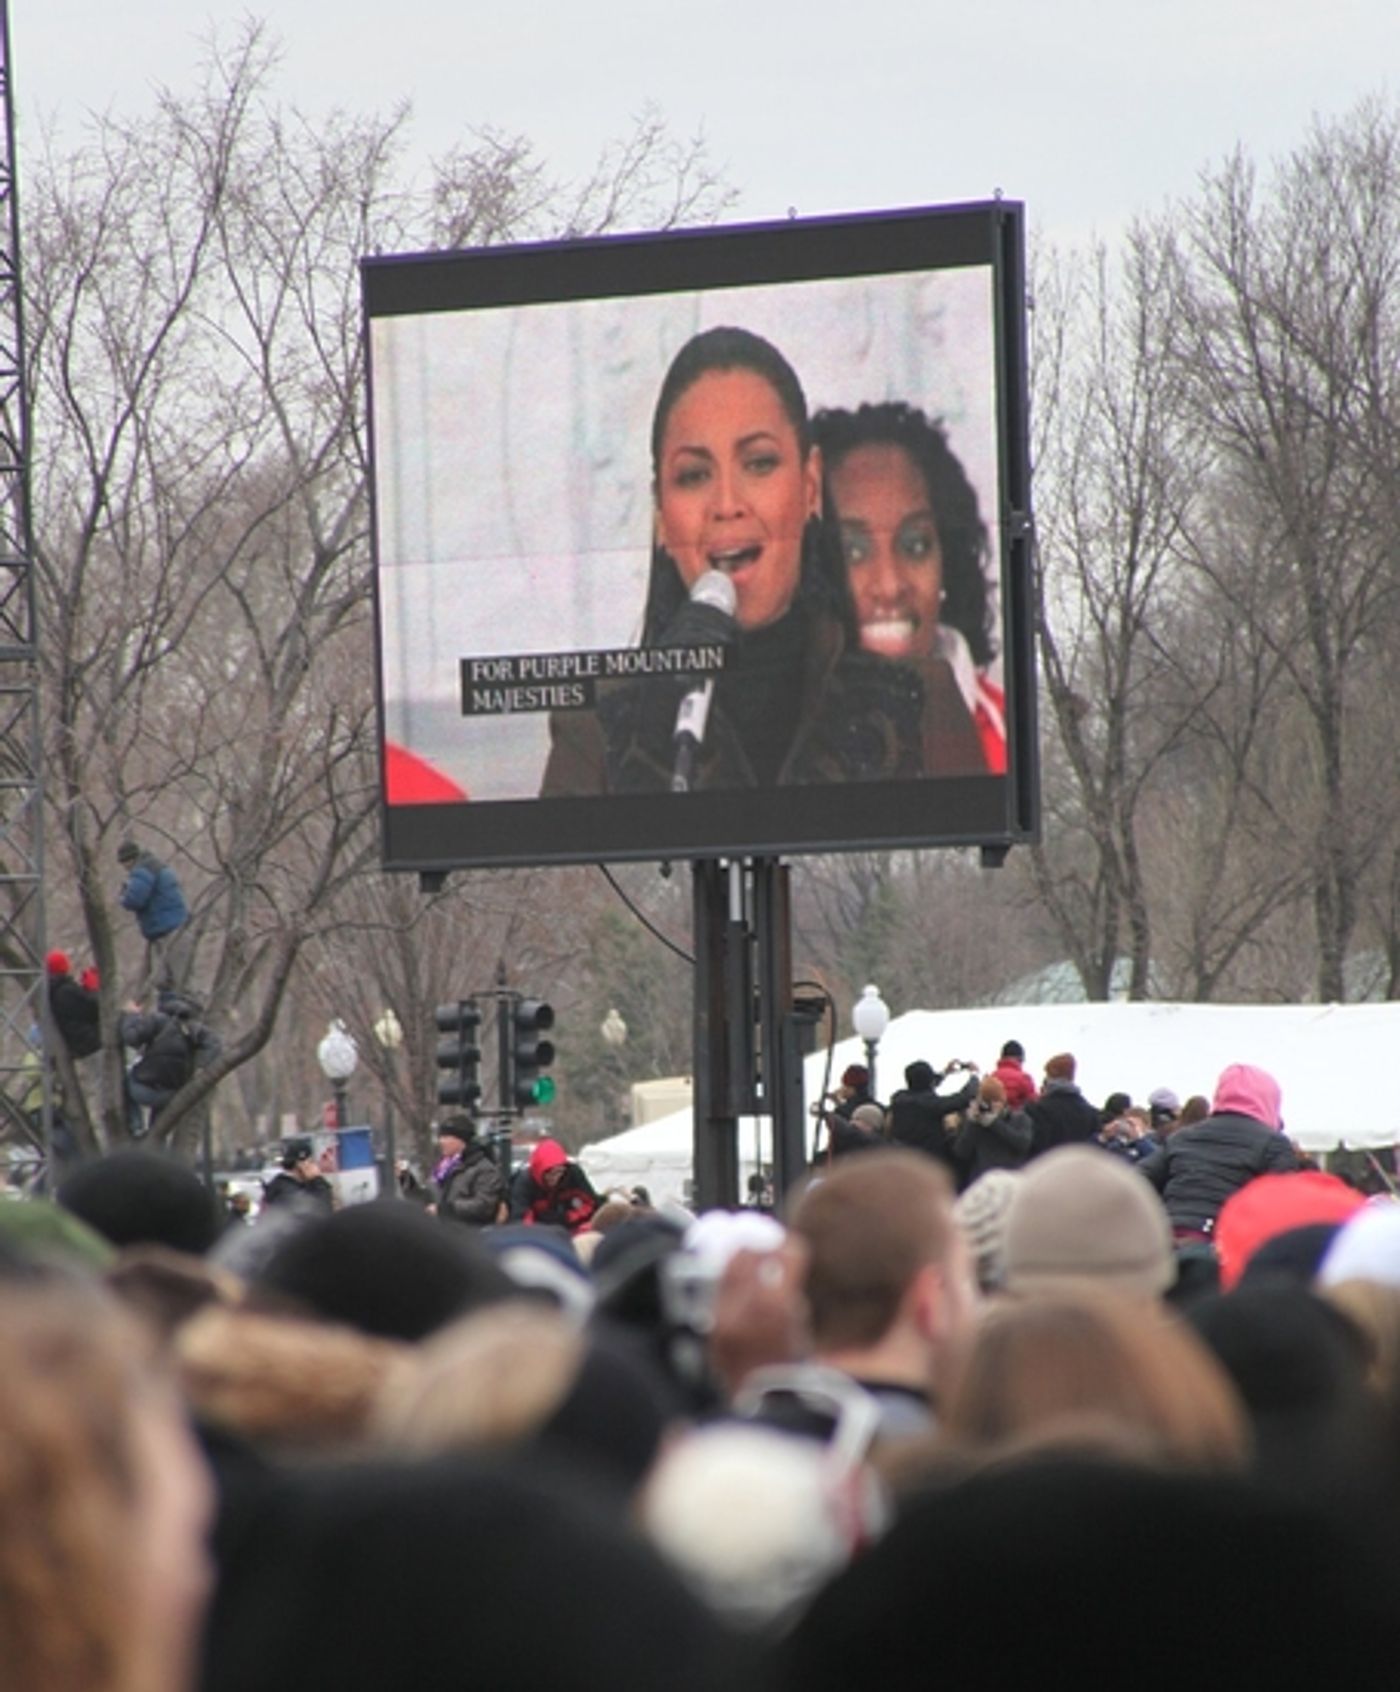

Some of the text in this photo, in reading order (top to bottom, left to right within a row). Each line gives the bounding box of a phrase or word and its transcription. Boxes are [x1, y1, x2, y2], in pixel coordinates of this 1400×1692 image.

[471, 646, 723, 682] FOR PURPLE MOUNTAIN
[472, 684, 585, 712] MAJESTIES
